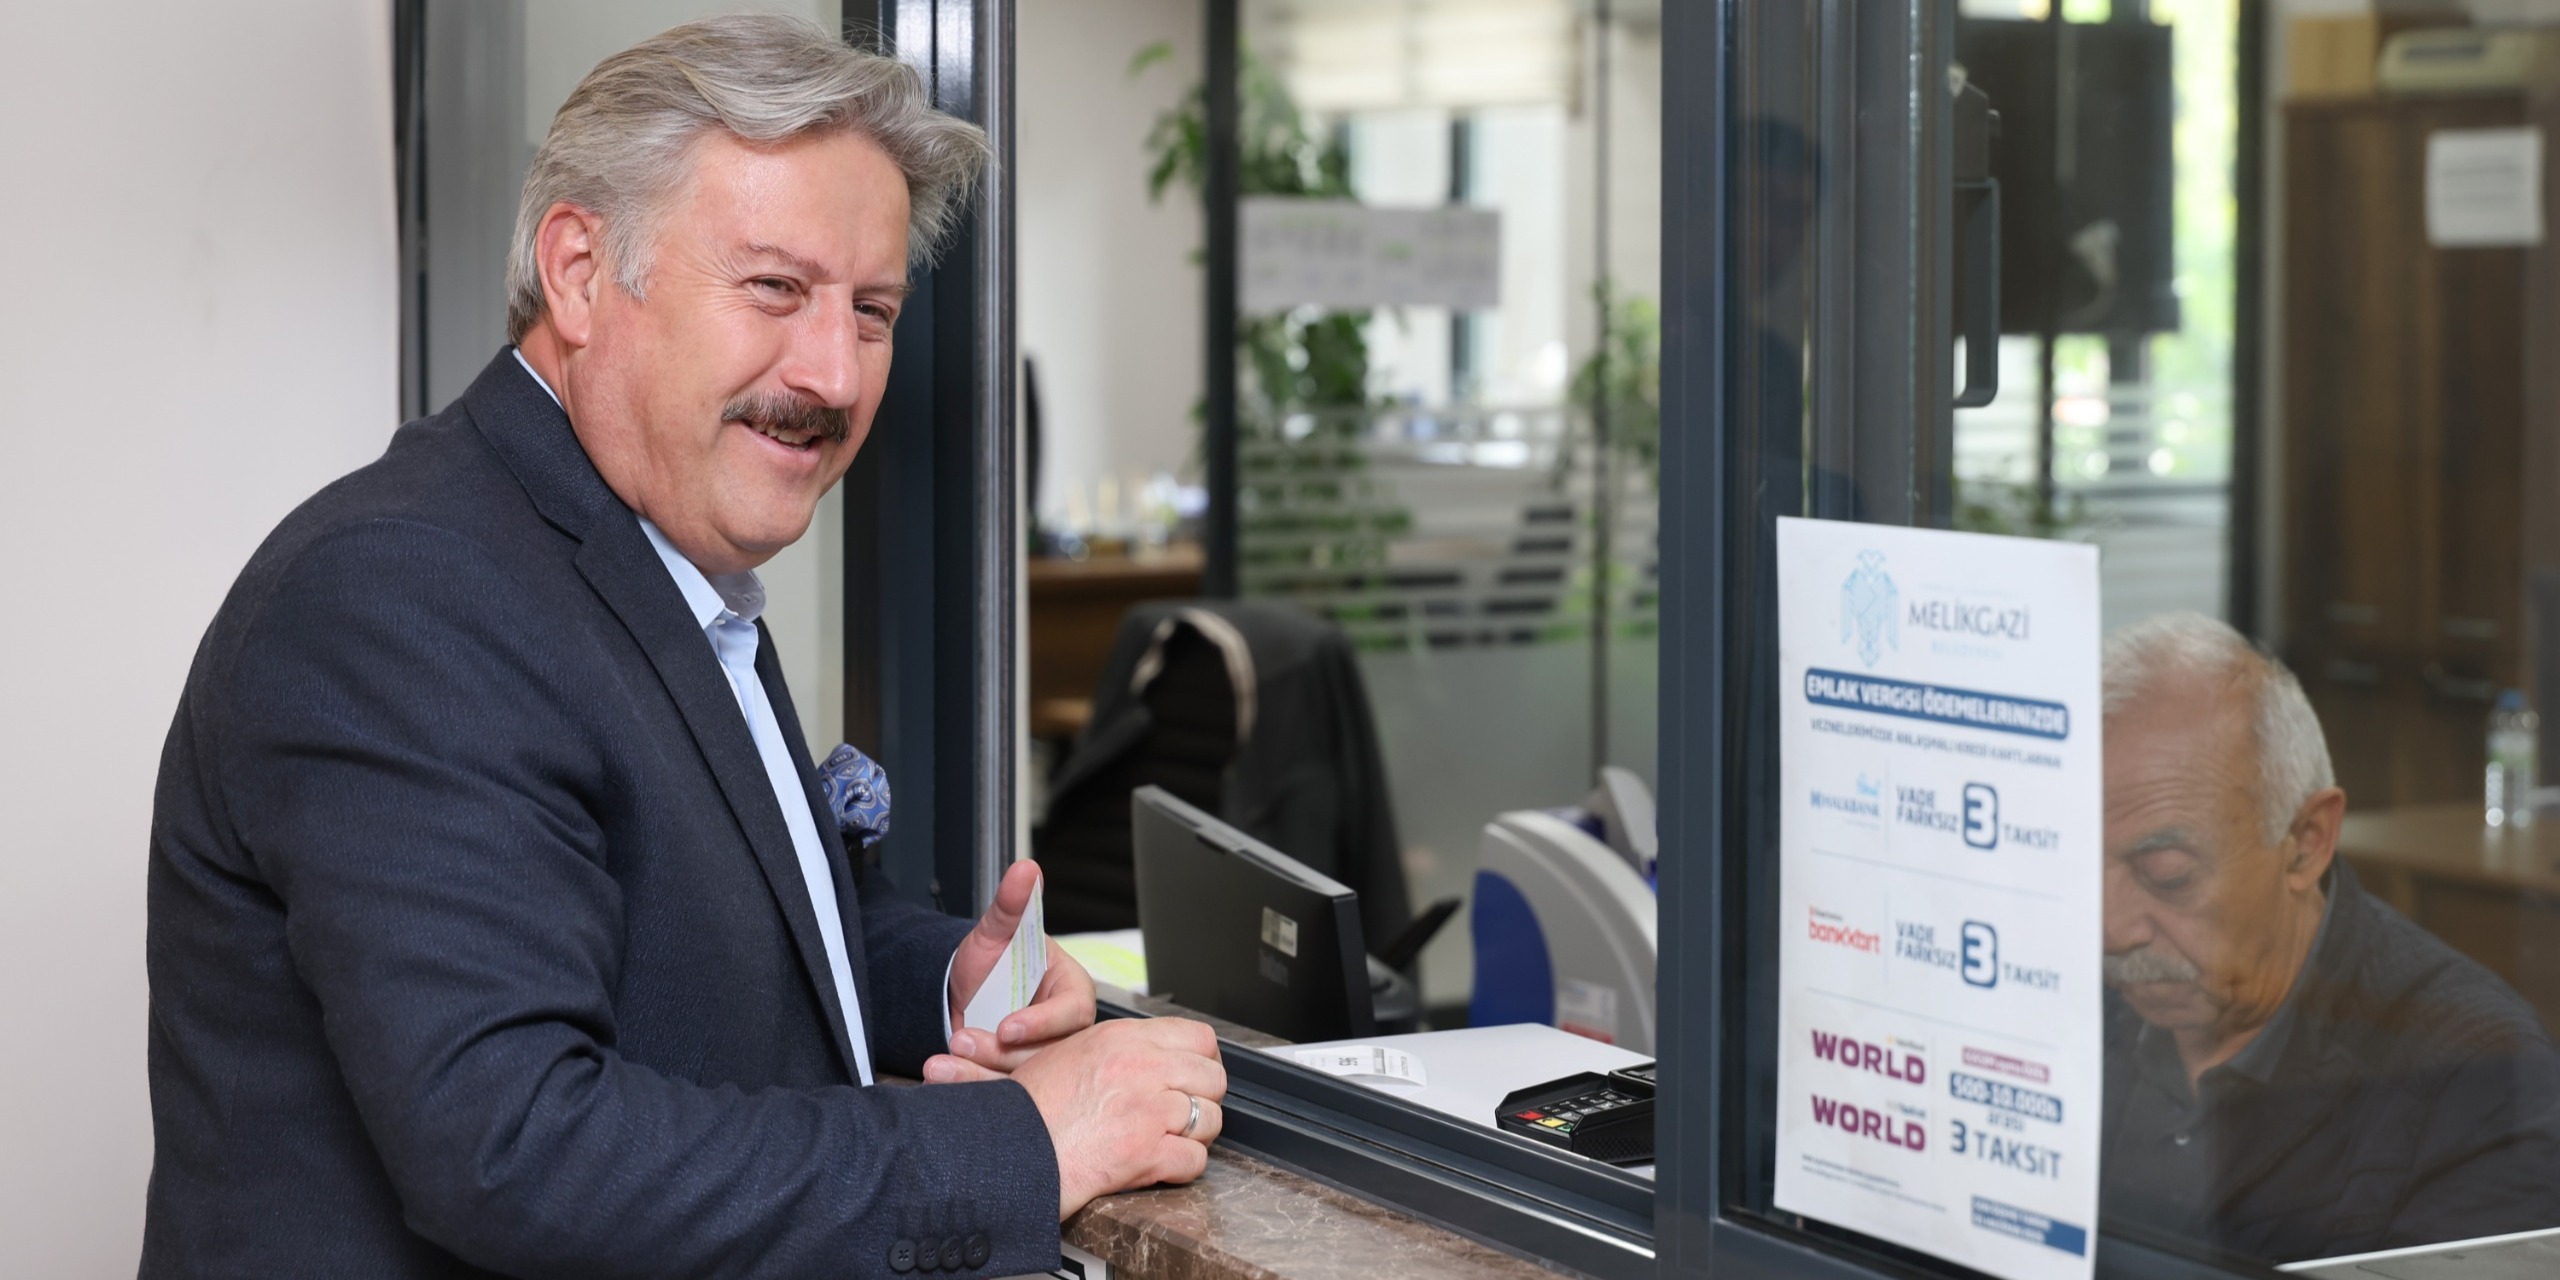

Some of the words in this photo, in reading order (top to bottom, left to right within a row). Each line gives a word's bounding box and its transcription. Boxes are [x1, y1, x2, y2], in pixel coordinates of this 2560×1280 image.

[1908, 601, 2031, 640] MELİKGAZİ
[1807, 674, 1859, 703] EMLAK
[1896, 785, 1936, 808] VADE
[1964, 783, 1998, 849] 3
[1896, 920, 1935, 943] VADE
[1962, 920, 1998, 988] 3
[1811, 1029, 1926, 1085] WORLD
[1811, 1095, 1926, 1152] WORLD
[1950, 1119, 1967, 1154] 3
[1974, 1130, 2062, 1180] TAKSİT
